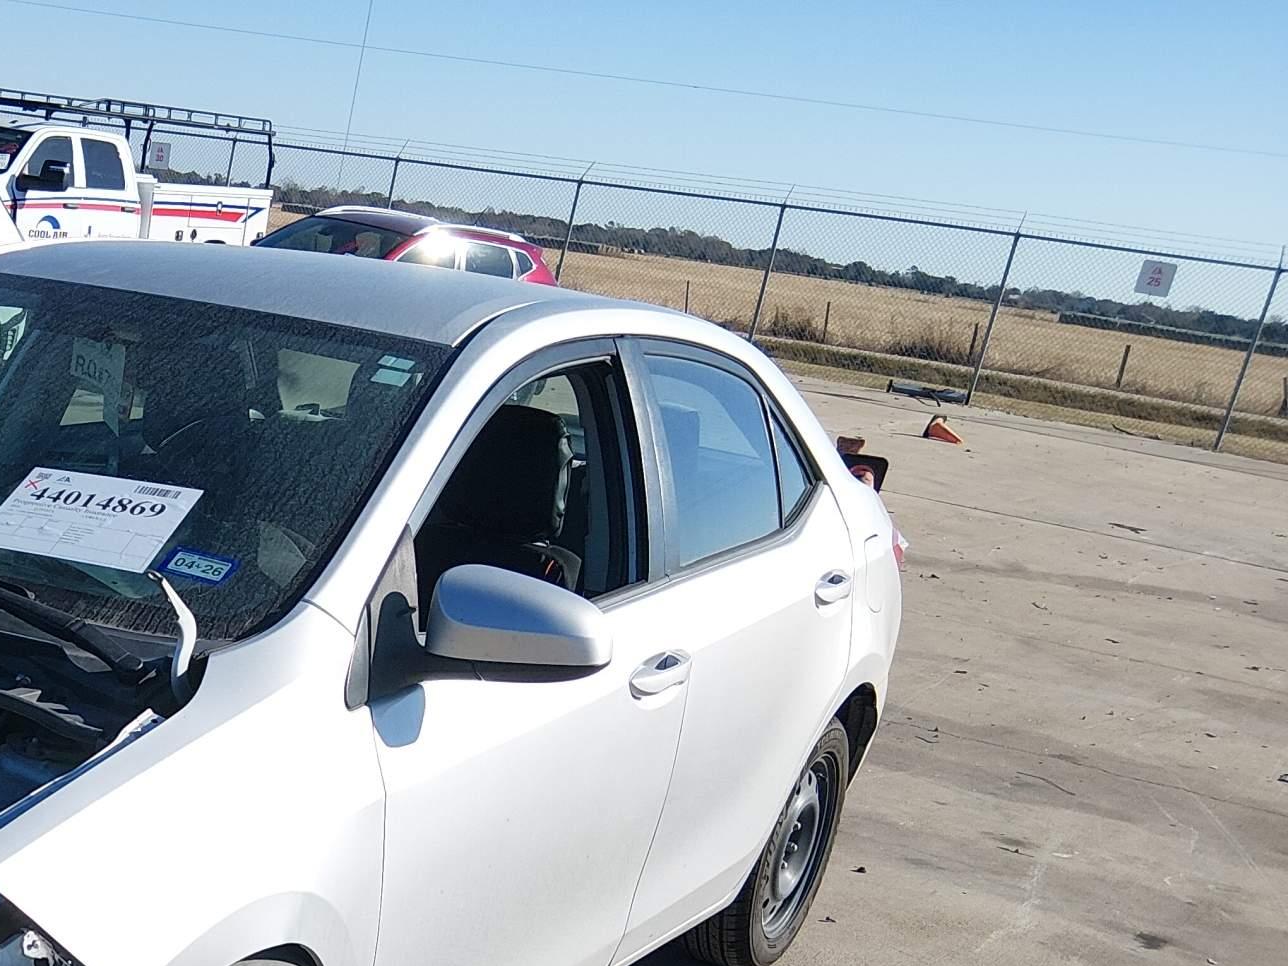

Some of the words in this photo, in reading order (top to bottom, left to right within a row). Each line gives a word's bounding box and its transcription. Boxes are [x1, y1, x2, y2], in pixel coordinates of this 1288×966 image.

[28, 229, 51, 239] COOL
[52, 231, 68, 240] AIR
[30, 486, 167, 518] 44014869
